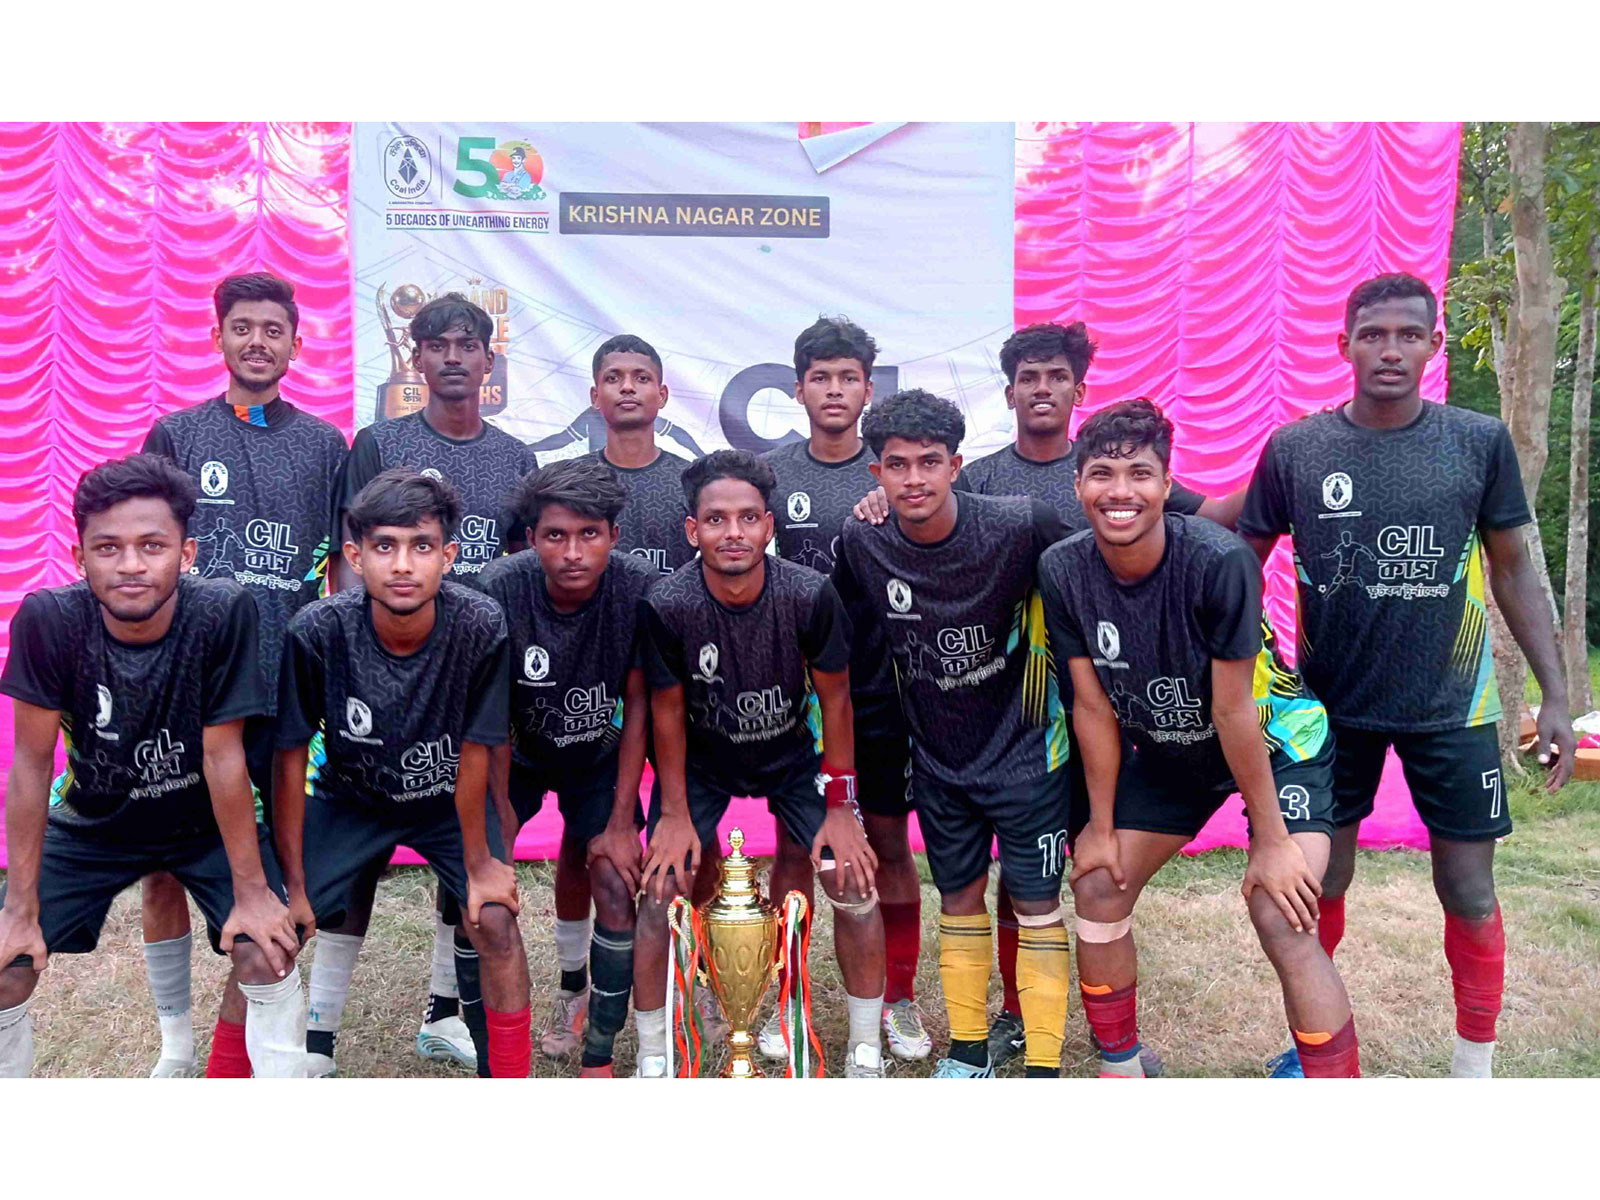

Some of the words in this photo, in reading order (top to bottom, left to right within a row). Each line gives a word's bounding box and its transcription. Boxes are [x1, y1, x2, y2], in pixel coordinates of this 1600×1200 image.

[390, 179, 407, 194] Coal
[408, 179, 426, 195] India
[386, 213, 393, 225] 5
[394, 214, 437, 226] DECADES
[439, 214, 451, 226] OF
[452, 215, 511, 228] UNEARTHING
[513, 216, 549, 229] ENERGY
[568, 205, 670, 224] KRISHNA
[676, 206, 755, 226] NAGAR
[760, 207, 822, 227] ZONE
[245, 518, 299, 555] CIL
[1377, 525, 1445, 557] CIL
[630, 547, 674, 575] IL
[937, 624, 995, 655] CIL
[564, 681, 617, 715] CIL
[736, 684, 792, 719] CIL
[400, 733, 460, 772] CIL
[1279, 784, 1310, 820] 3
[1482, 768, 1501, 818] 7
[1037, 829, 1068, 878] 10
